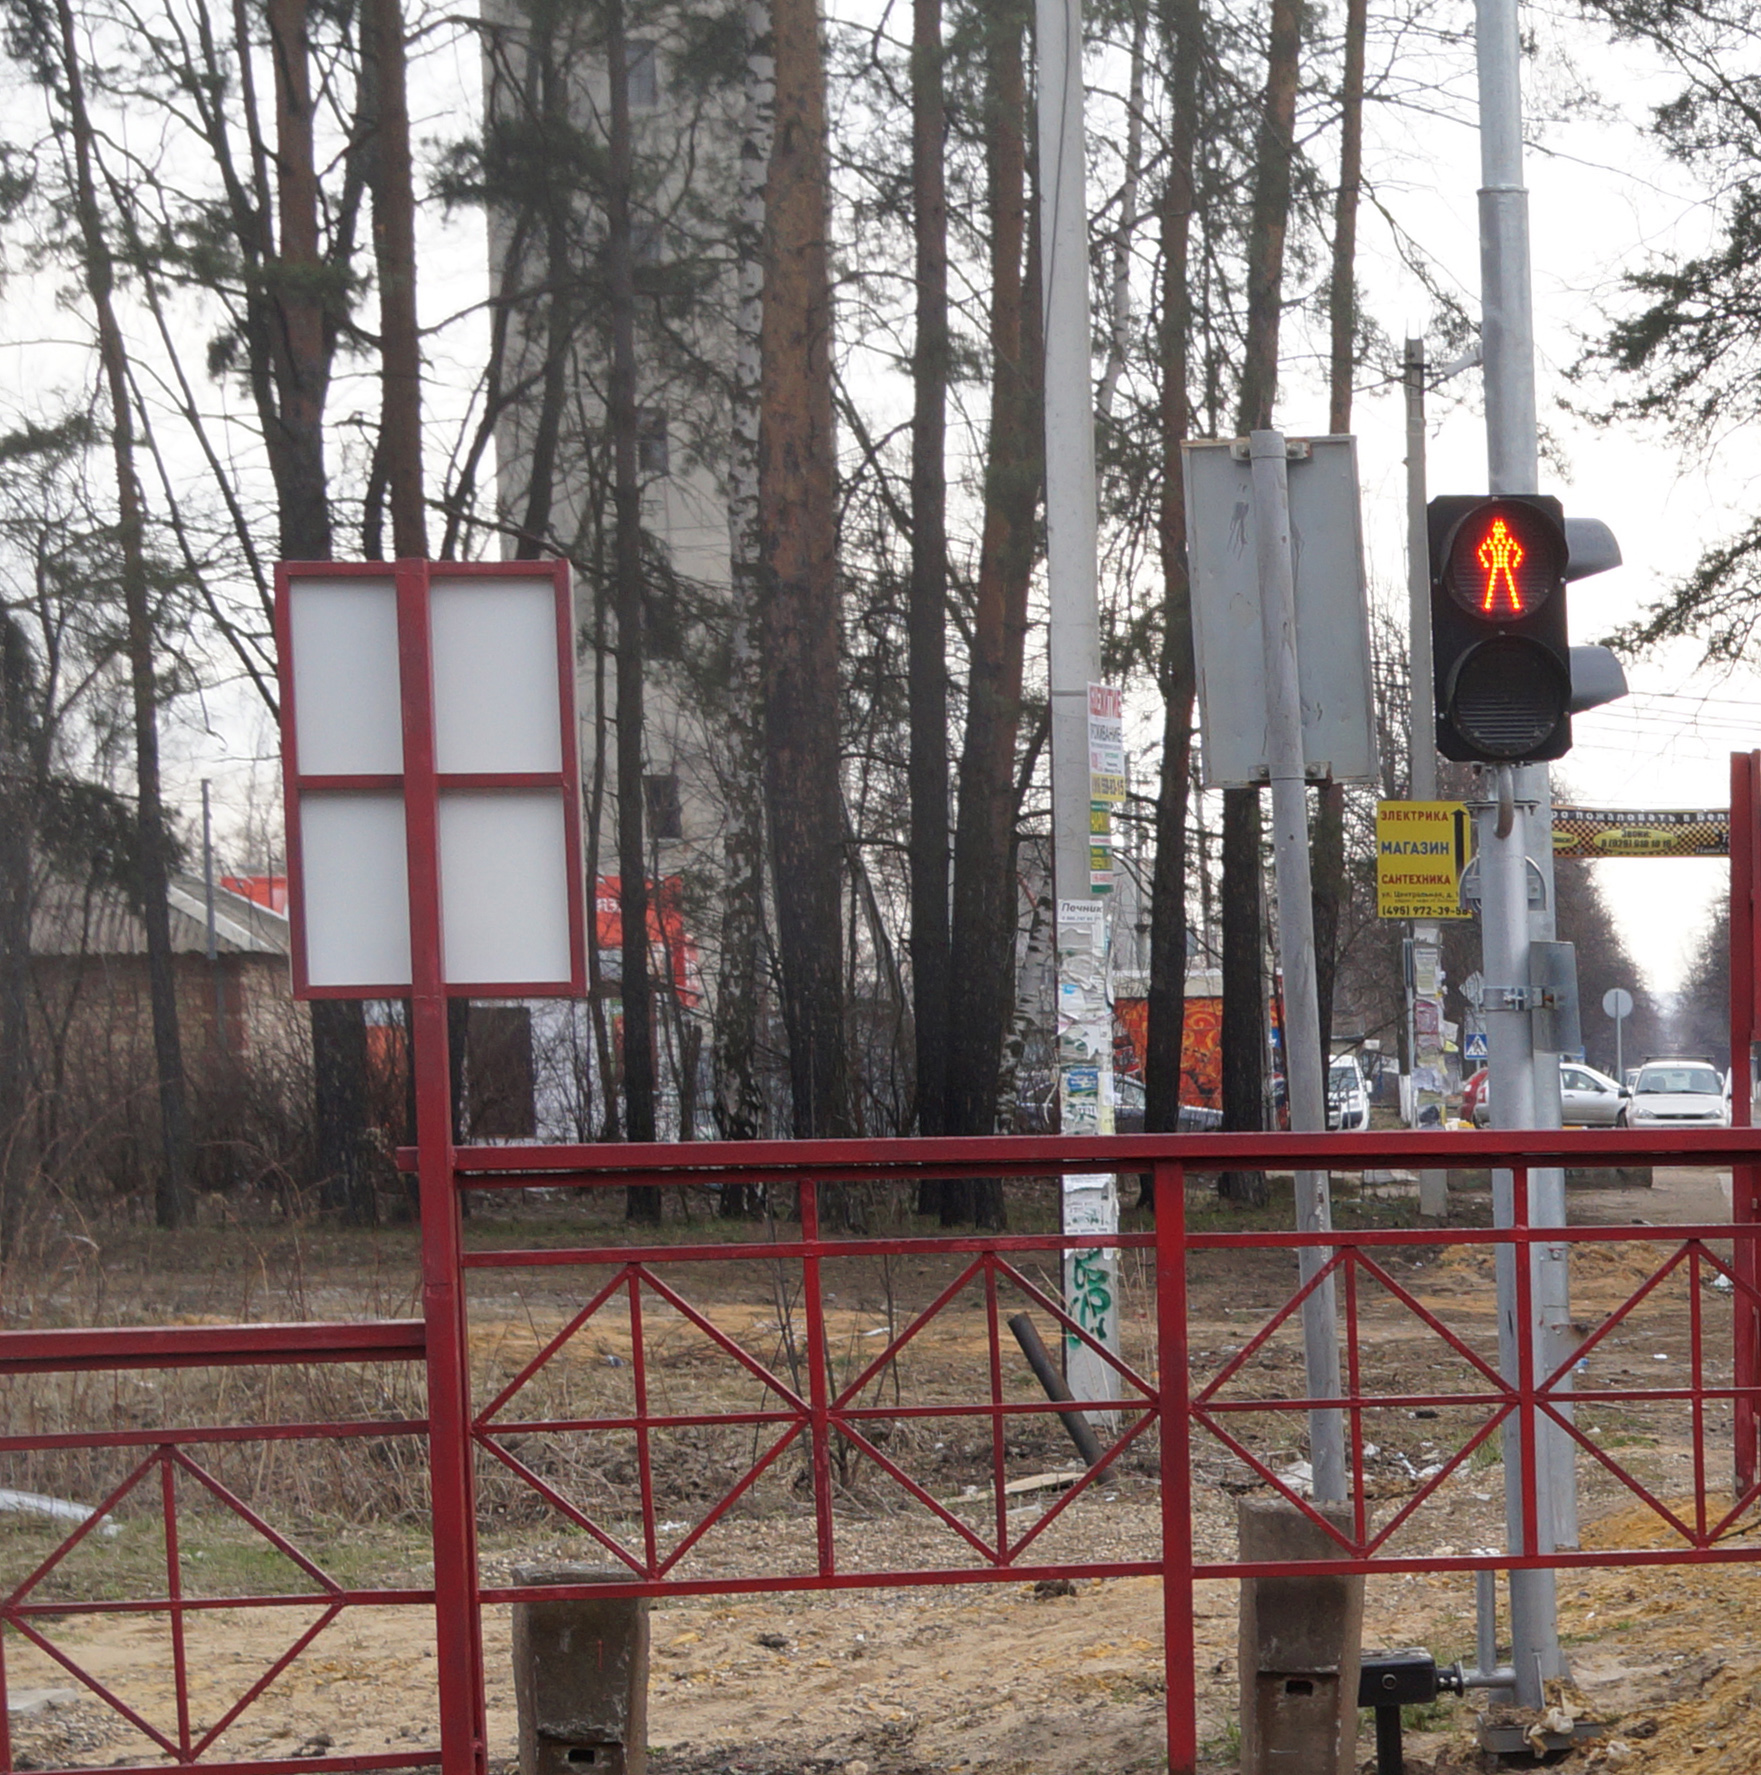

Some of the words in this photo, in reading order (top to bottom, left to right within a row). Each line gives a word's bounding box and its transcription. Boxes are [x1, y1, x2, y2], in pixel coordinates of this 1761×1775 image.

[1380, 810, 1449, 821] ЭЛЕКТРИКА
[1575, 811, 1676, 823] пожаловать
[1683, 813, 1691, 822] в
[1381, 841, 1449, 855] МАГАЗИН
[1381, 874, 1451, 885] САНТЕХНИКА
[1382, 905, 1410, 916] (495)
